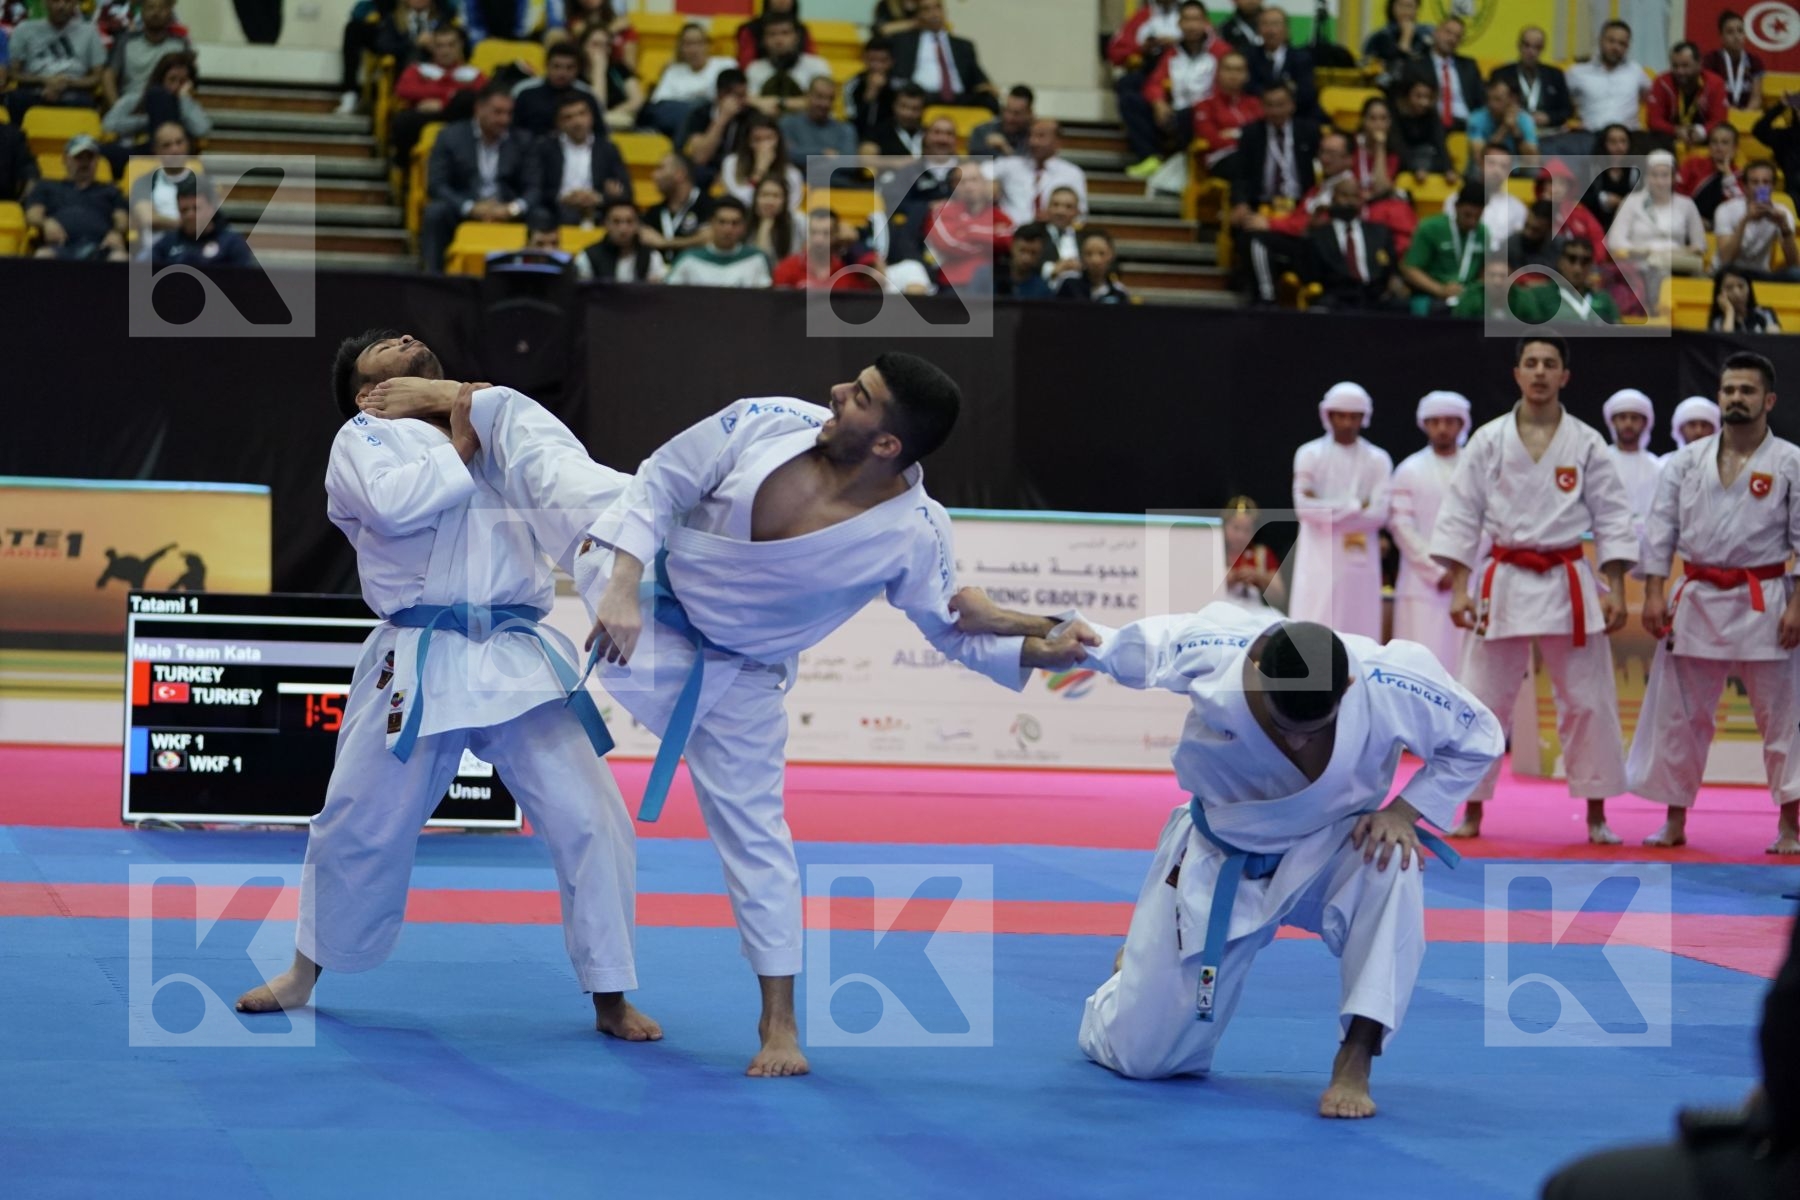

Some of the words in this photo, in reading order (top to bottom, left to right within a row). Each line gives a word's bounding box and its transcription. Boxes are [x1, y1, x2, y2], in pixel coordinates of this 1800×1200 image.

[130, 595, 186, 613] Tatami
[189, 597, 199, 613] 1
[133, 643, 172, 659] Male
[176, 644, 221, 660] Team
[224, 645, 262, 661] Kata
[154, 665, 225, 683] TURKEY
[191, 687, 263, 706] TURKEY
[1367, 668, 1453, 712] Arawaza
[305, 692, 349, 731] 1:5
[151, 732, 192, 750] WKF
[195, 734, 204, 751] 1
[189, 755, 230, 773] WKF
[233, 756, 242, 773] 1
[449, 783, 492, 800] Unsu
